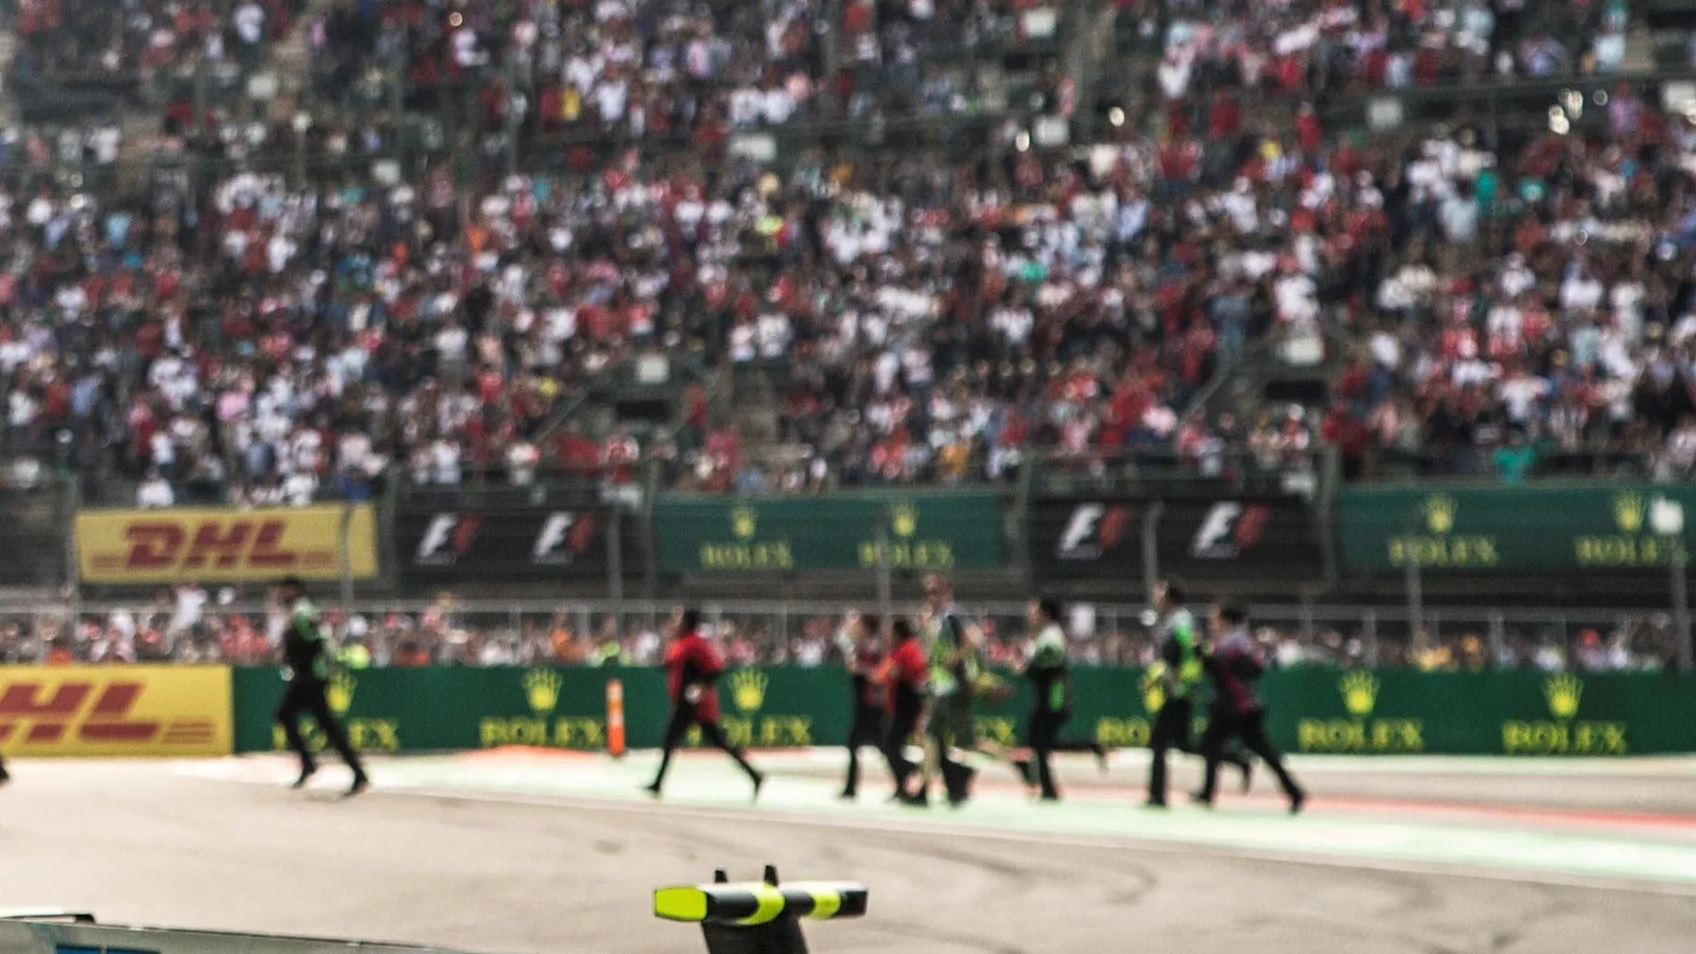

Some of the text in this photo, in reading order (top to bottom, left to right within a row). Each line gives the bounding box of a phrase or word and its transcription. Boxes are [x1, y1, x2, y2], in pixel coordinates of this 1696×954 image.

[126, 521, 298, 568] DHL
[1298, 719, 1422, 751] ROLEX
[1502, 720, 1626, 753] ROLEX
